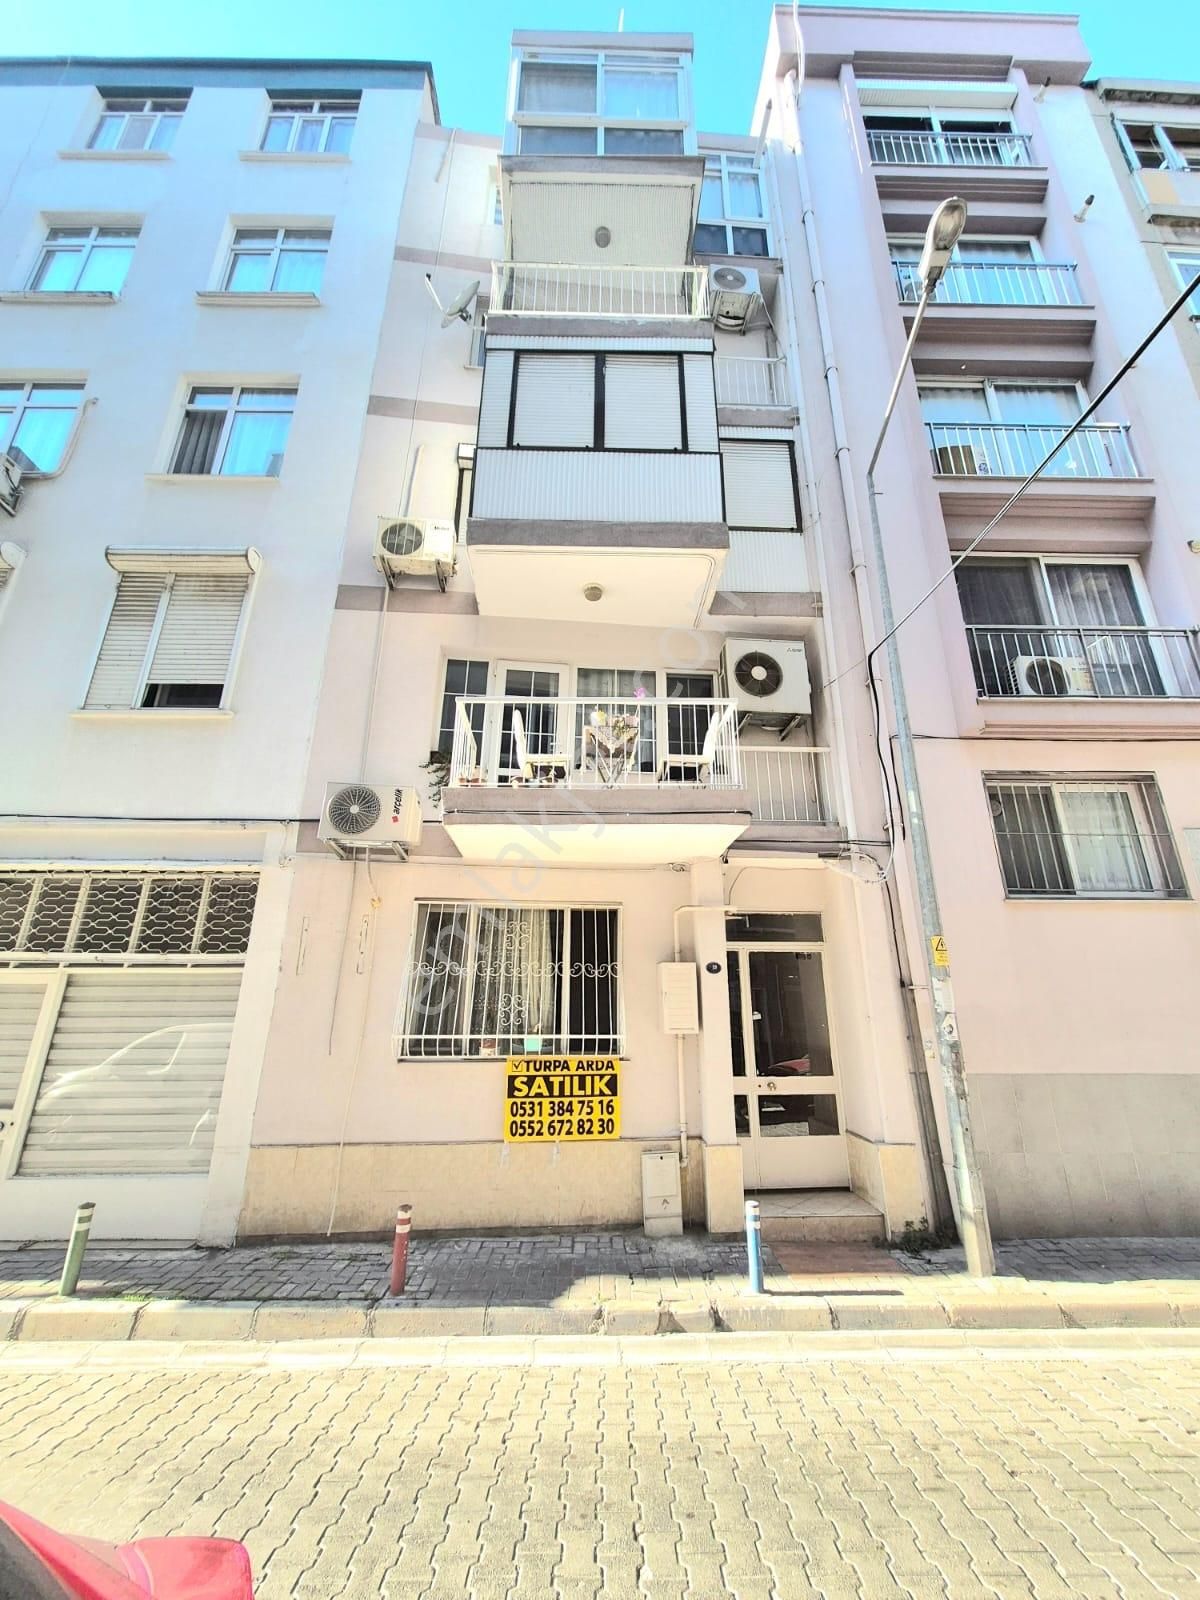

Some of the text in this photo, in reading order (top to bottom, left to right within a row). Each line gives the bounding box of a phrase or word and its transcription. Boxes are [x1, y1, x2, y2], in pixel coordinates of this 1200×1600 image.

[525, 1060, 615, 1073] TURPA ARDA
[513, 1075, 612, 1097] SATILIK
[510, 1099, 615, 1118] 0531 384 75 16
[509, 1118, 615, 1137] 0552 672 82 30
